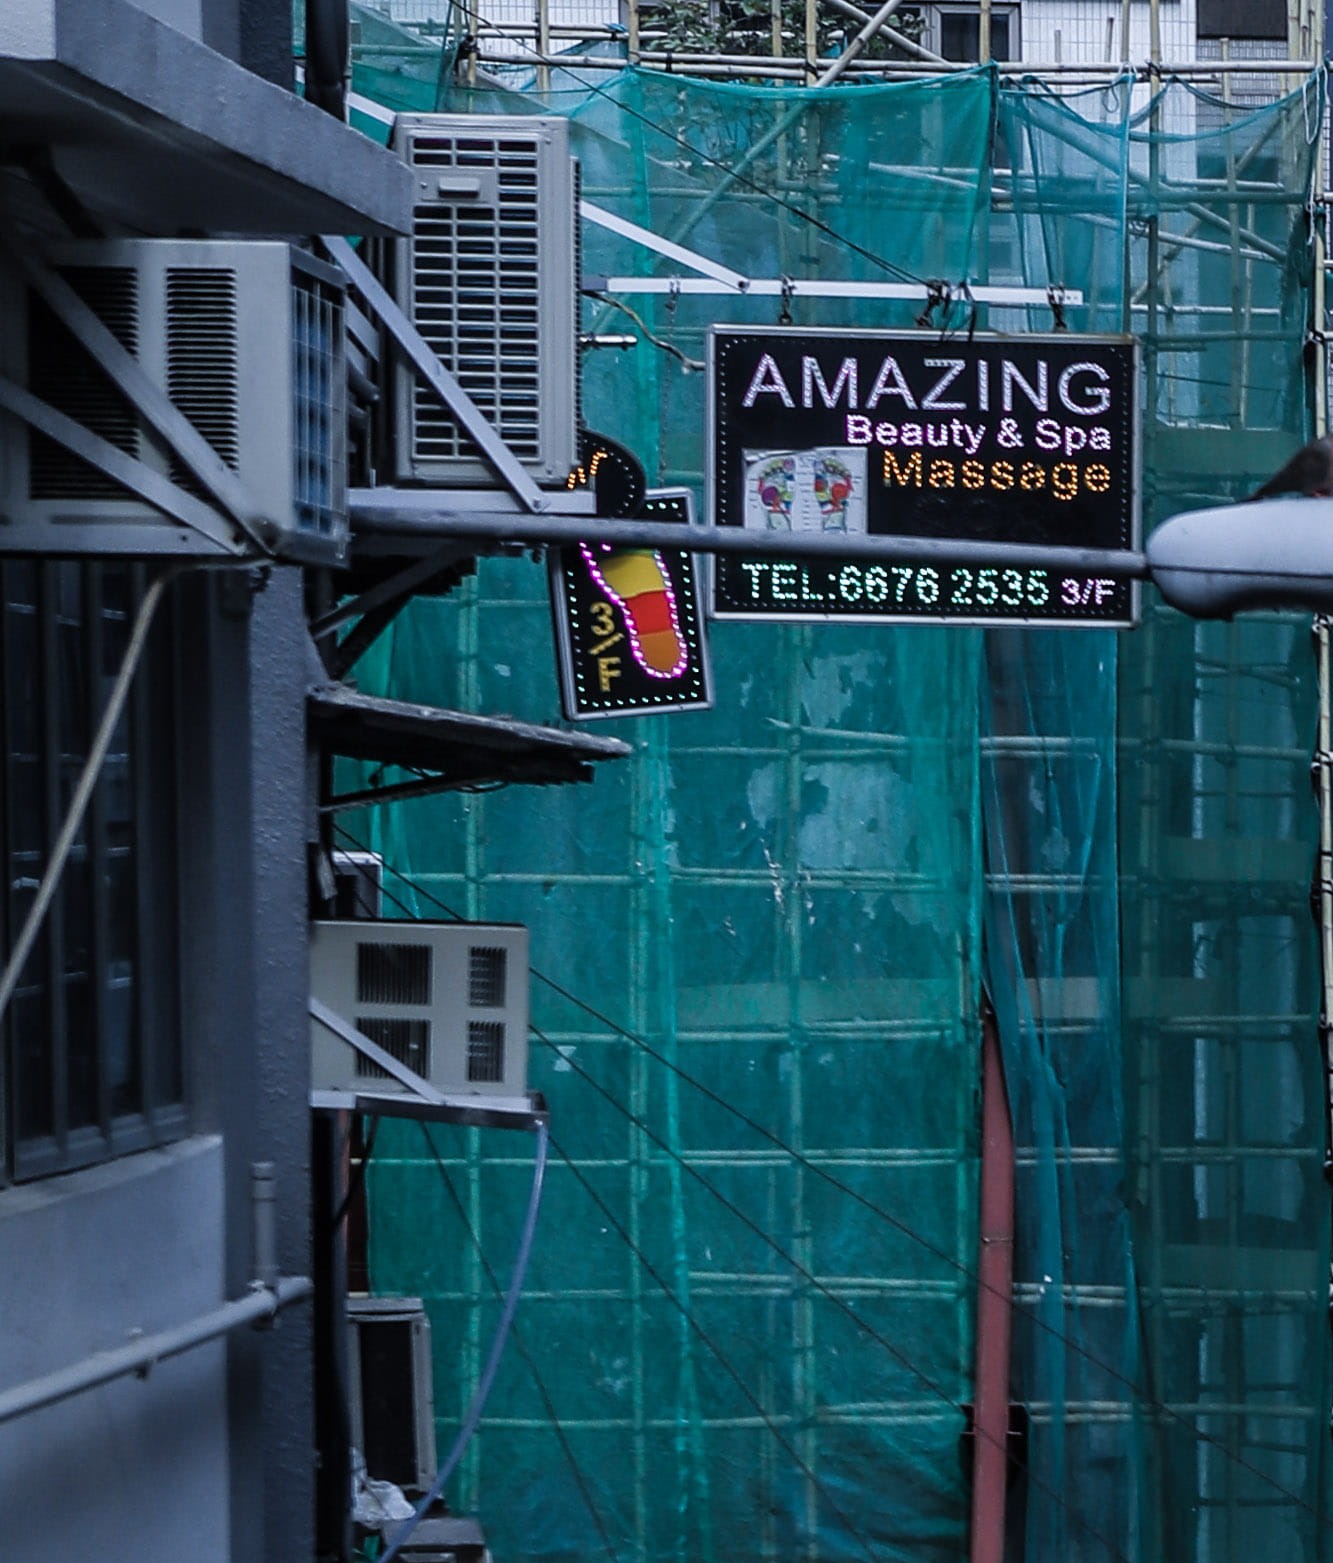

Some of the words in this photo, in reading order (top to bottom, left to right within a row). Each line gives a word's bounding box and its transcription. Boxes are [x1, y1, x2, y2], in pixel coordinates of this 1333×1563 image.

[741, 353, 1111, 416] AMAZING
[845, 415, 986, 455] Beauty
[997, 418, 1025, 449] &
[1035, 418, 1112, 456] Spa
[883, 450, 1111, 501] Massage
[951, 566, 1049, 606] 2535
[1061, 577, 1116, 608] 3/F
[589, 601, 620, 692] 3/F
